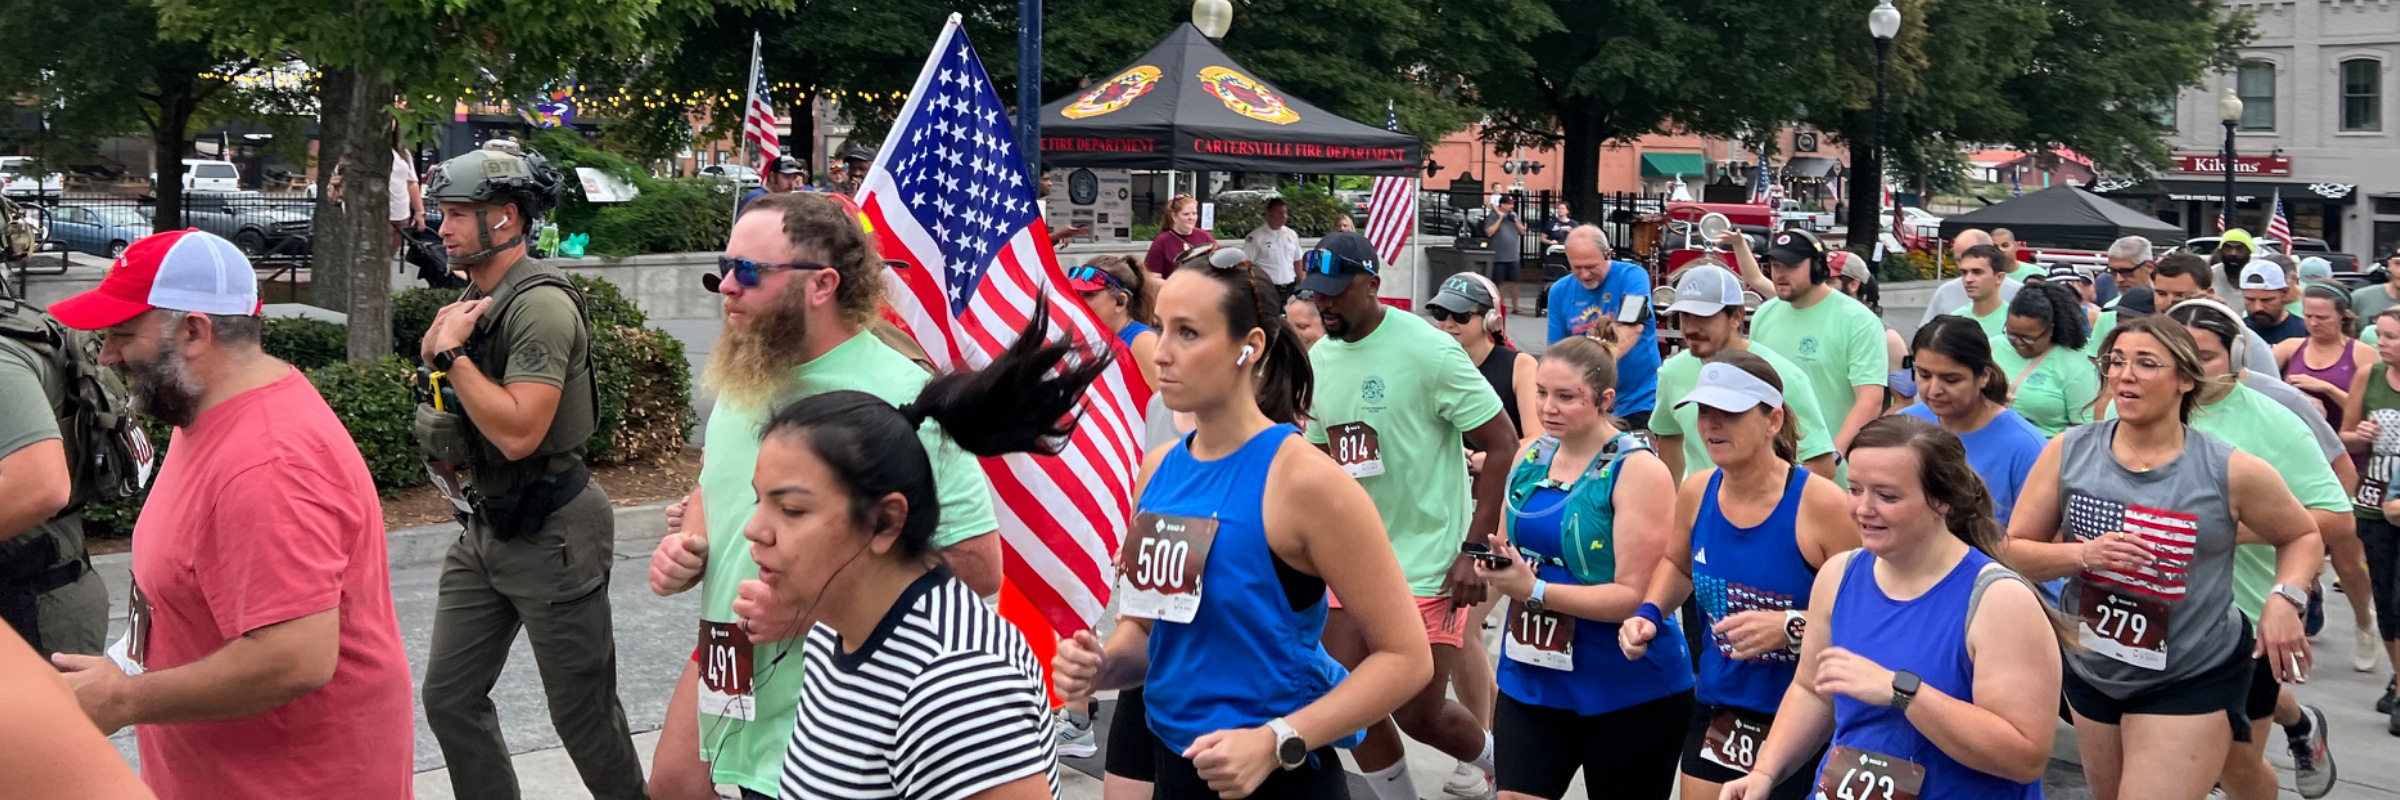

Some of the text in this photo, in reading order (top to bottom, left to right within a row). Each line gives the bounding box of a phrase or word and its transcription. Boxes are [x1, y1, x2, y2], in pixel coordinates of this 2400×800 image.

[1049, 137, 1074, 151] FIRE
[1077, 137, 1155, 152] DEPARTMENT
[1194, 139, 1406, 161] CARTERSVILLE FIRE DEPARTMENT
[1340, 433, 1368, 462] 814
[1137, 537, 1189, 588] 500
[1520, 611, 1558, 647] 117
[2096, 604, 2148, 645] 279
[708, 644, 738, 690] 491
[1722, 729, 1765, 767] 48
[1836, 768, 1895, 800] 423
